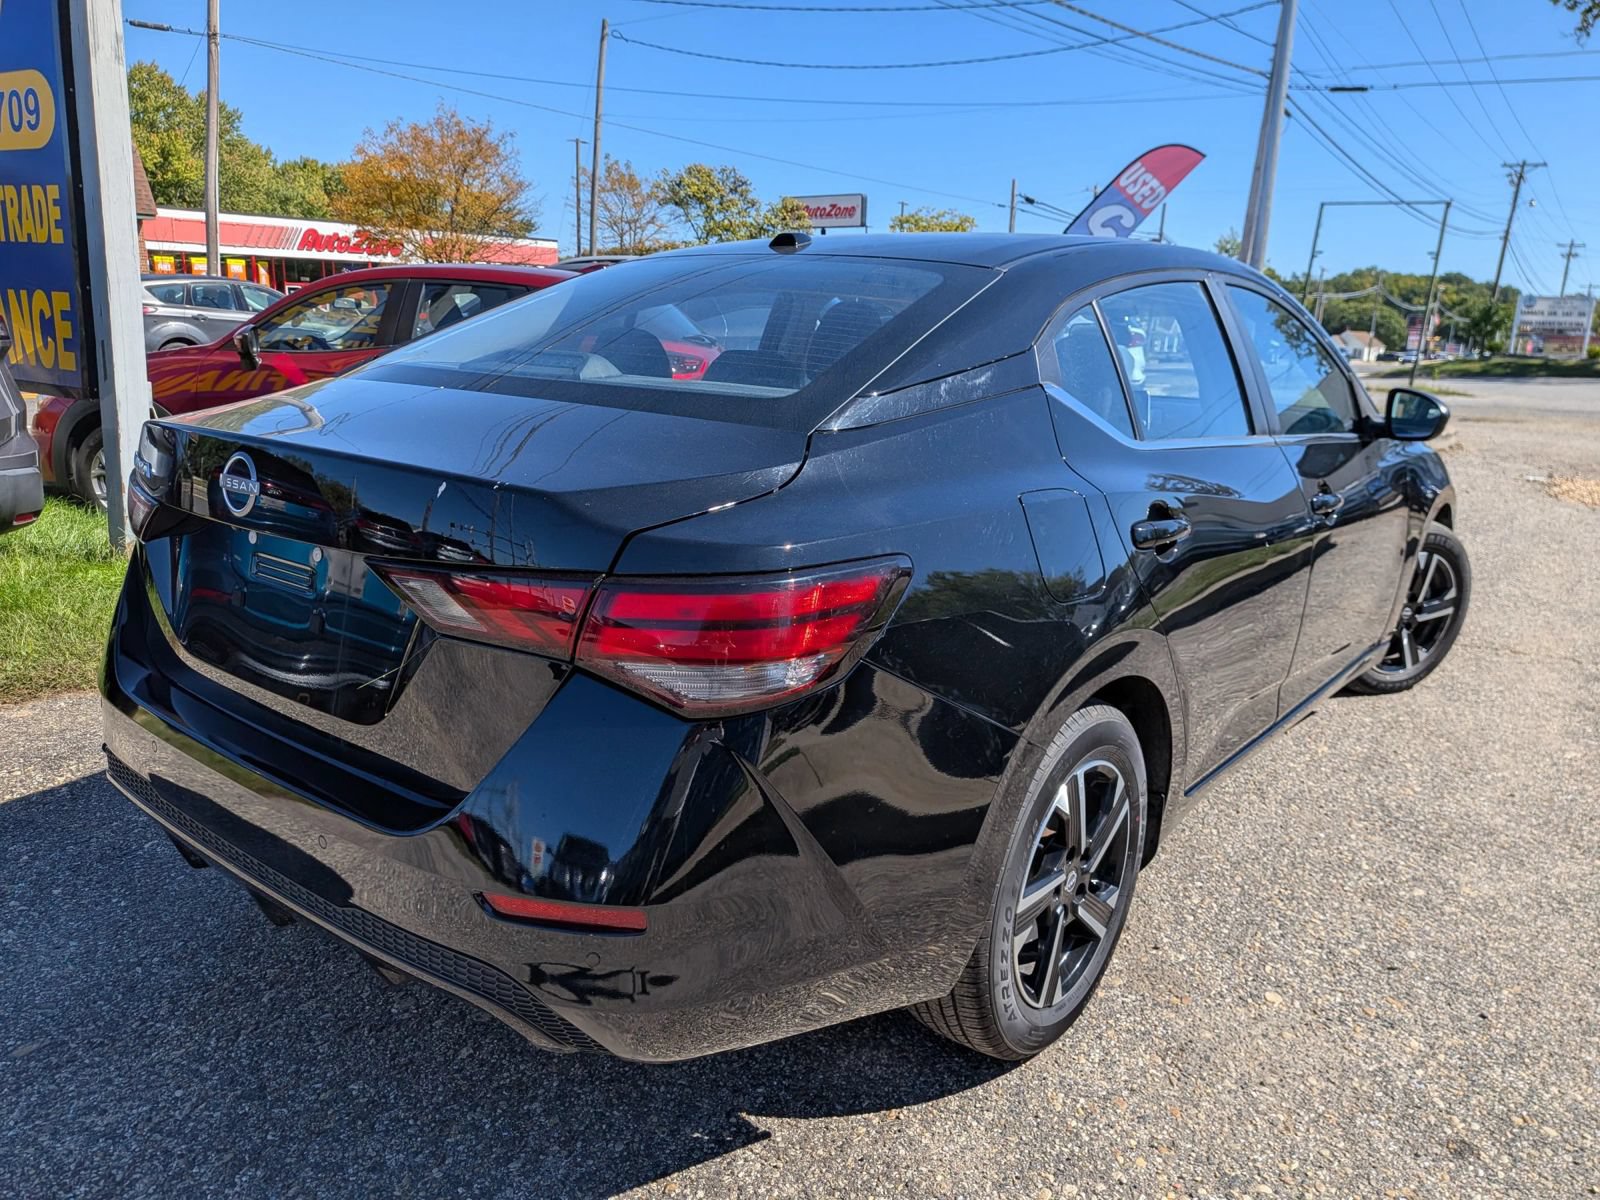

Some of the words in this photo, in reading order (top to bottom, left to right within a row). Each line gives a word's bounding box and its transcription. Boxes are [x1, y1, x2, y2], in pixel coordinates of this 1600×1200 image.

[1118, 160, 1168, 209] USED
[220, 476, 259, 494] NISSAN
[1000, 905, 1018, 1022] ATREZZO
